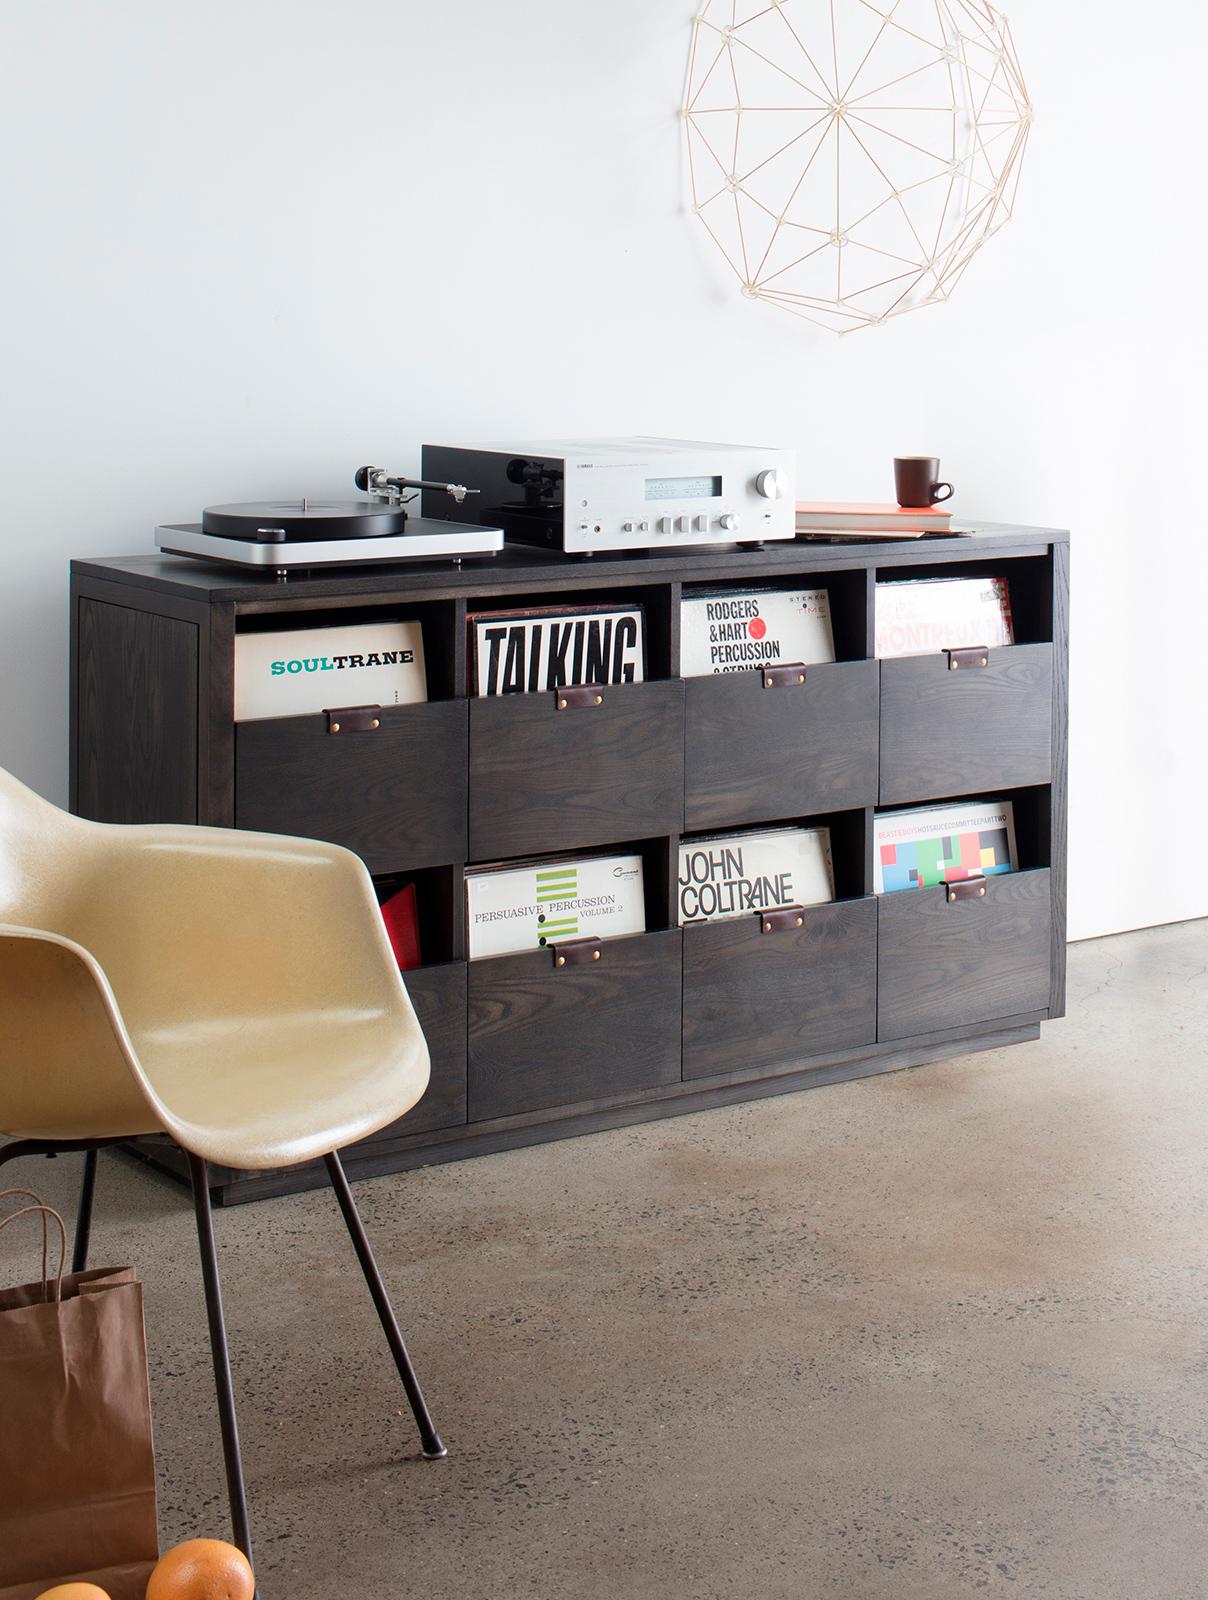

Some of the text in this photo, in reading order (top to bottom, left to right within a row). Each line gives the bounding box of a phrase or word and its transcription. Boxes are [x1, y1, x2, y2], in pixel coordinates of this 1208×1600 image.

[706, 600, 760, 621] RODGERS
[271, 650, 414, 675] SOULTRANE
[485, 616, 637, 695] TALKING
[710, 640, 781, 664] PERCUSSION
[678, 847, 744, 886] JOHN
[680, 872, 794, 918] COLTRANE
[475, 894, 616, 924] PERSUASIVE PERCUSSION
[580, 905, 624, 918] VOLUME 2
